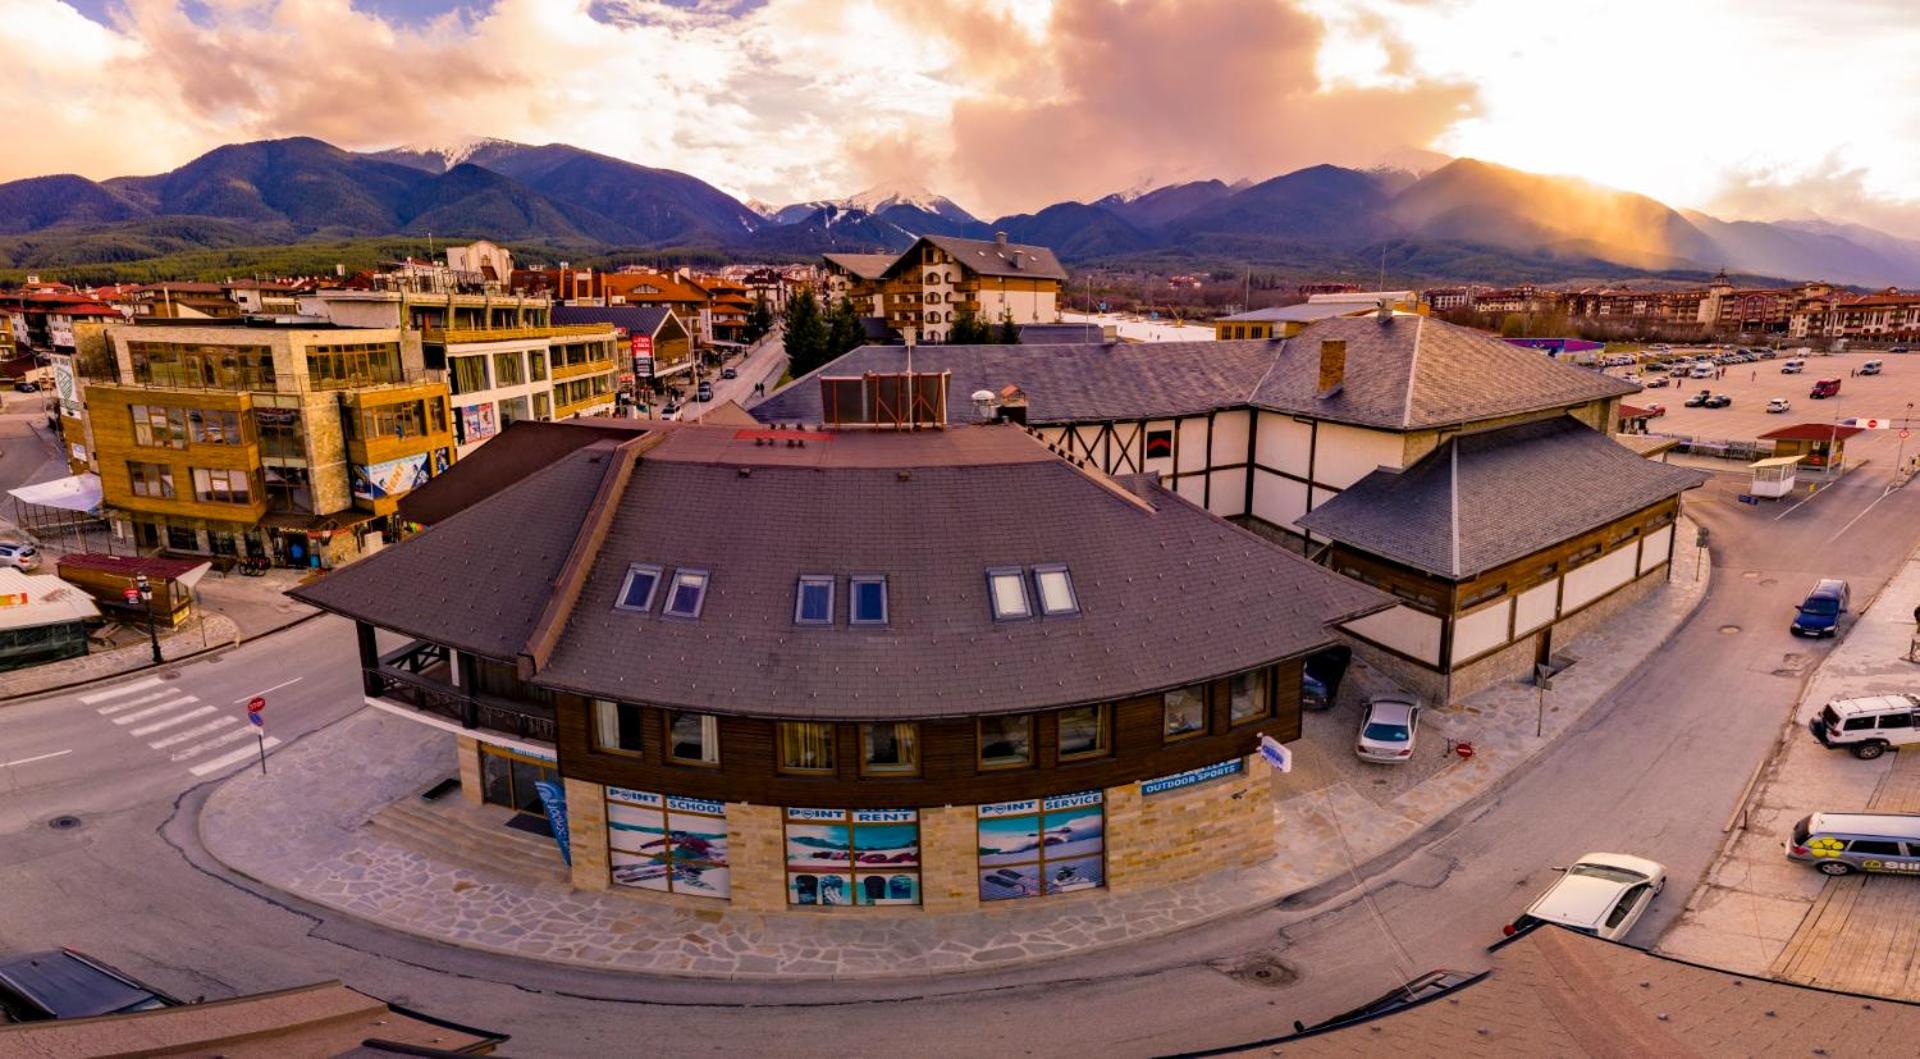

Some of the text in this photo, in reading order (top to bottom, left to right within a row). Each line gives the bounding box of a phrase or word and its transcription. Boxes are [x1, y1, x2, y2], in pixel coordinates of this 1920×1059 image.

[1146, 765, 1236, 793] OUTDOOR SPORTS
[669, 801, 725, 814] SCHOOL
[982, 794, 1100, 815] POINT SERVICE
[790, 809, 910, 821] POINT RENT
